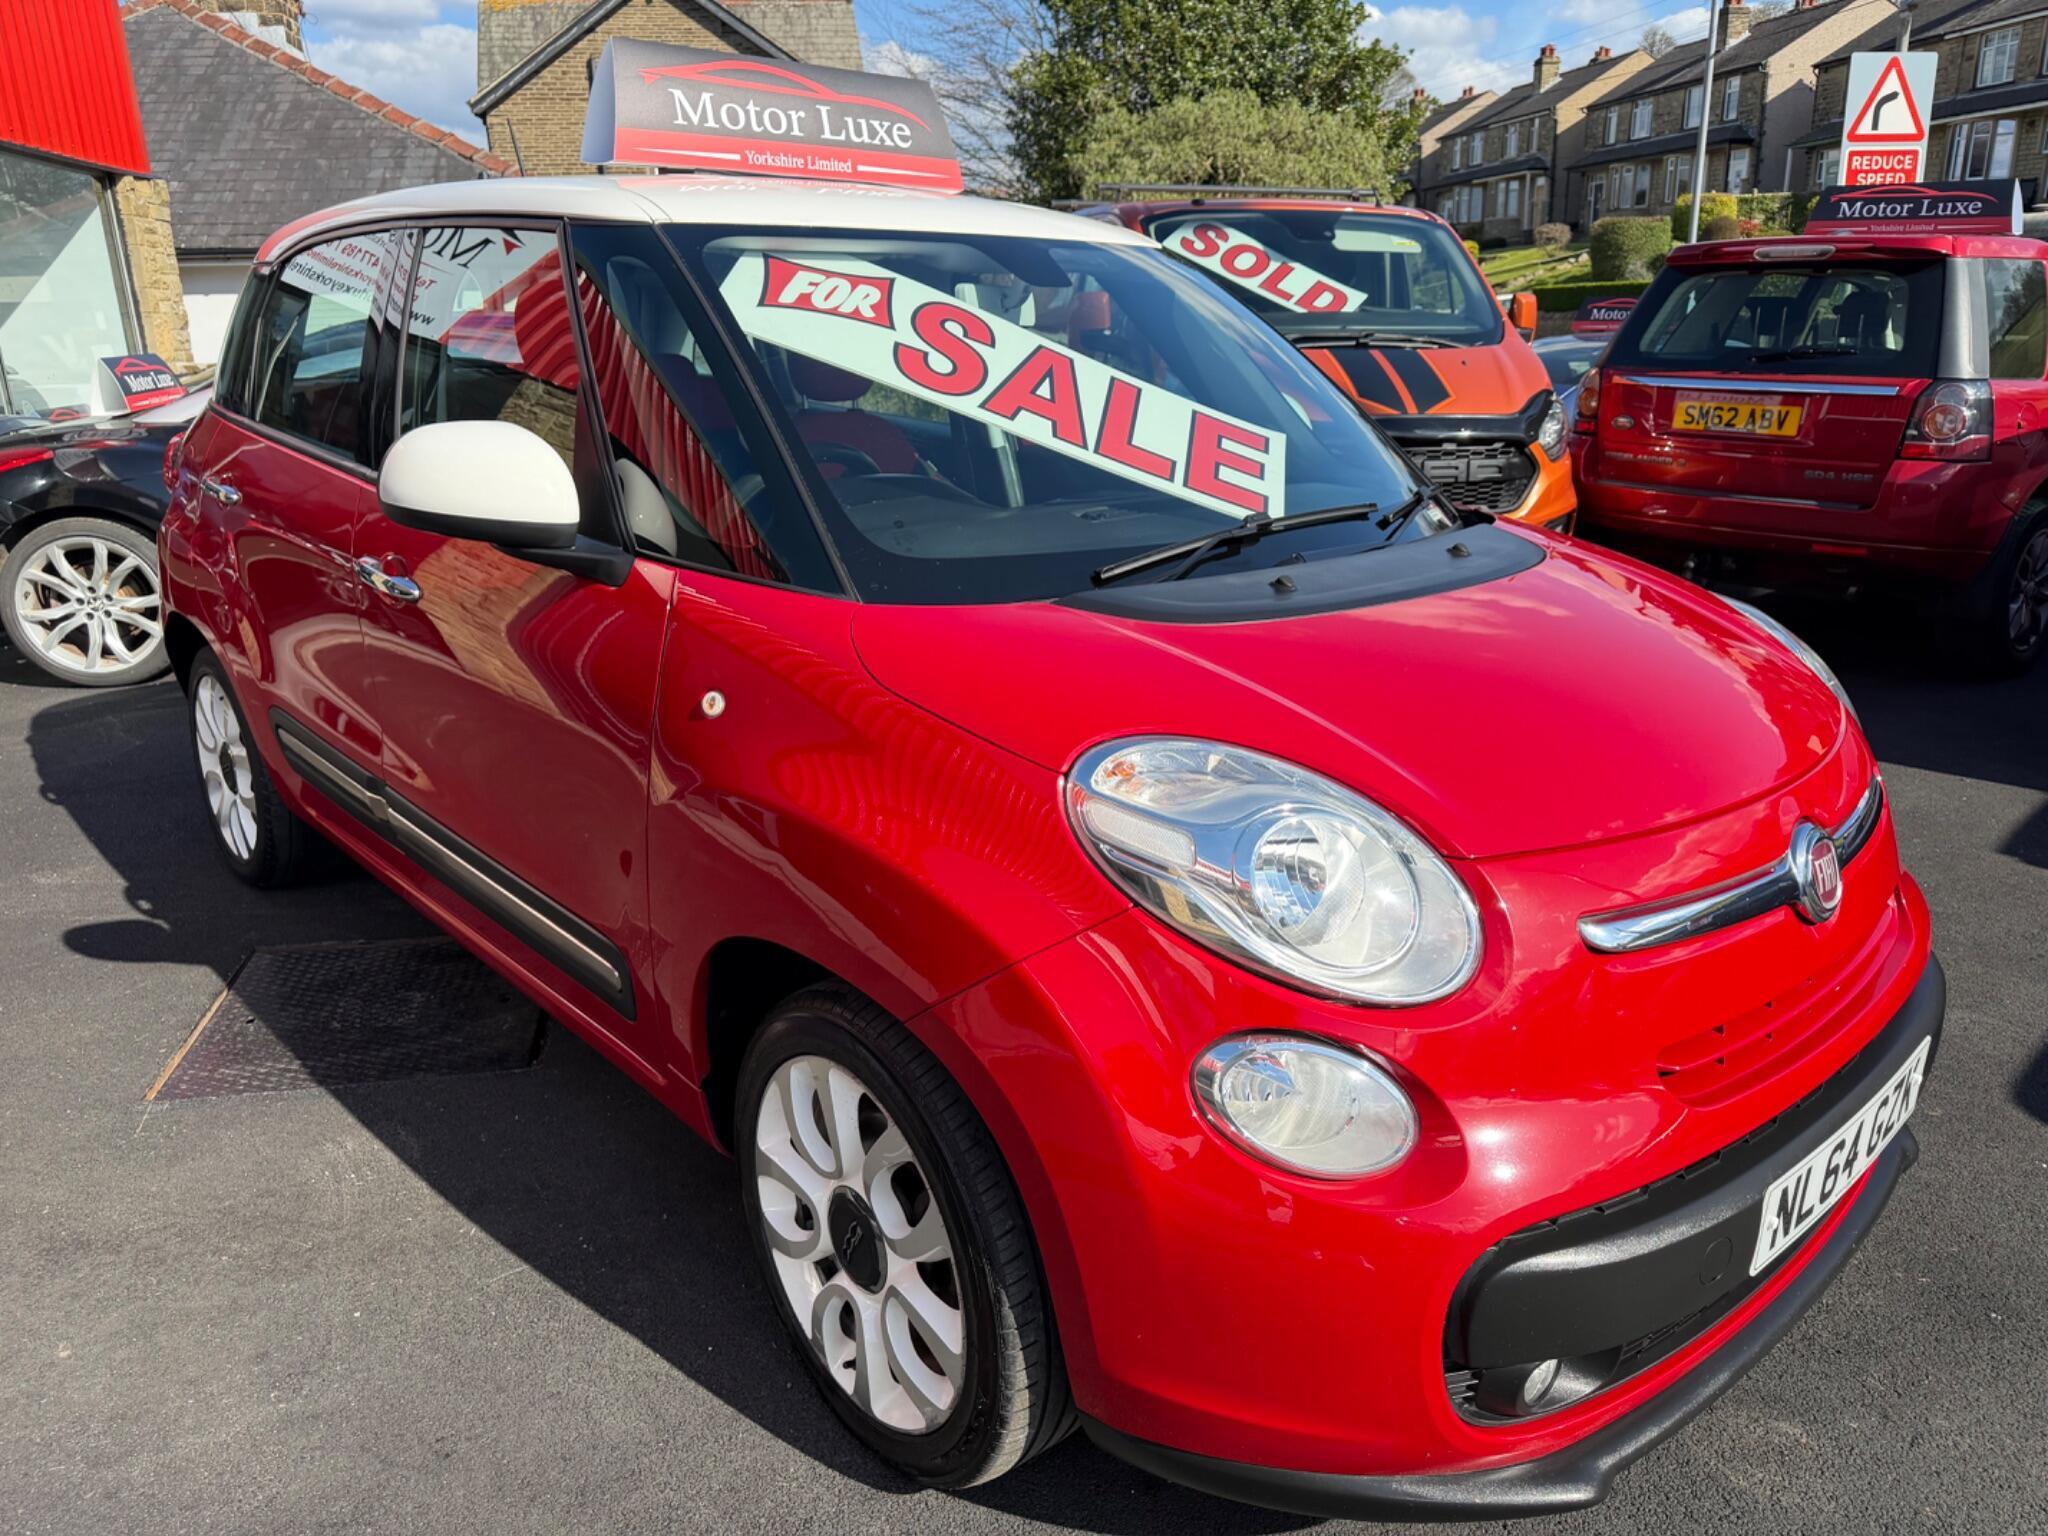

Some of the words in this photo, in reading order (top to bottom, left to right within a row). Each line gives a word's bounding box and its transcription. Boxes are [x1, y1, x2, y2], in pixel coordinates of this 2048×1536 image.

[668, 88, 806, 136] Motor
[815, 104, 913, 148] Luxe
[745, 150, 805, 169] Yorkshire
[807, 157, 852, 174] Limited
[1851, 155, 1914, 170] REDUCE
[1837, 201, 1914, 218] Motor
[1919, 199, 1982, 217] Luxe
[1180, 223, 1349, 312] SOLD
[777, 272, 883, 318] FOR
[893, 301, 1270, 514] SALE
[1683, 404, 1739, 428] SM62
[1744, 407, 1790, 431] ABV
[1770, 1119, 1864, 1251] NL64
